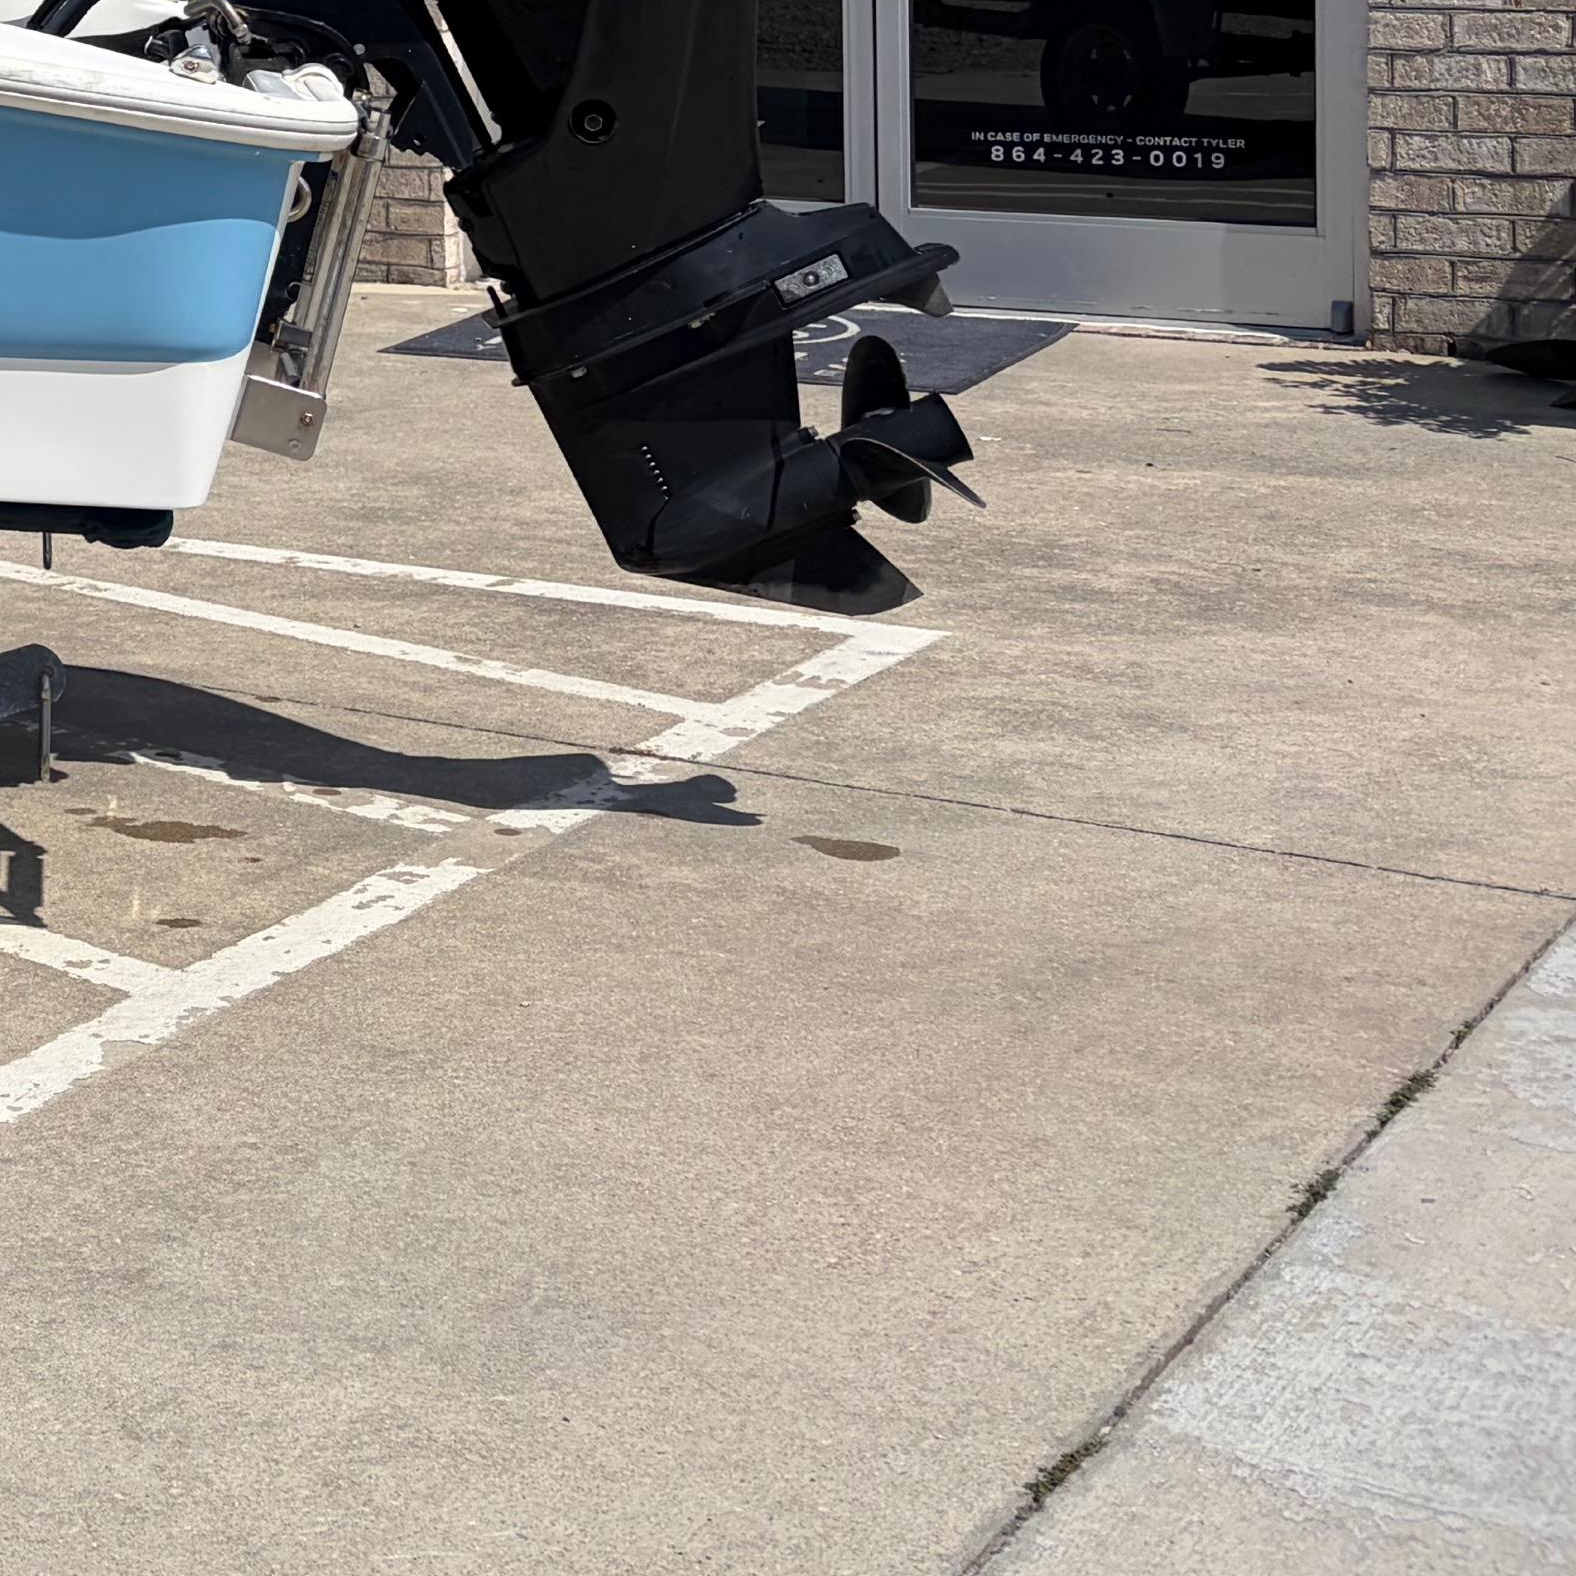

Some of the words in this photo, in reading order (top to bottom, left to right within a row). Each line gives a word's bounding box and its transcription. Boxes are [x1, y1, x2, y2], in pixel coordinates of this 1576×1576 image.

[971, 131, 985, 141] IN
[987, 132, 1021, 142] CASE
[1023, 133, 1041, 142] OF
[1043, 133, 1124, 145] EMERGENCY
[1136, 136, 1198, 147] CONTACT
[1200, 138, 1246, 149] TYLER
[990, 145, 1226, 169] 864-423-0019
